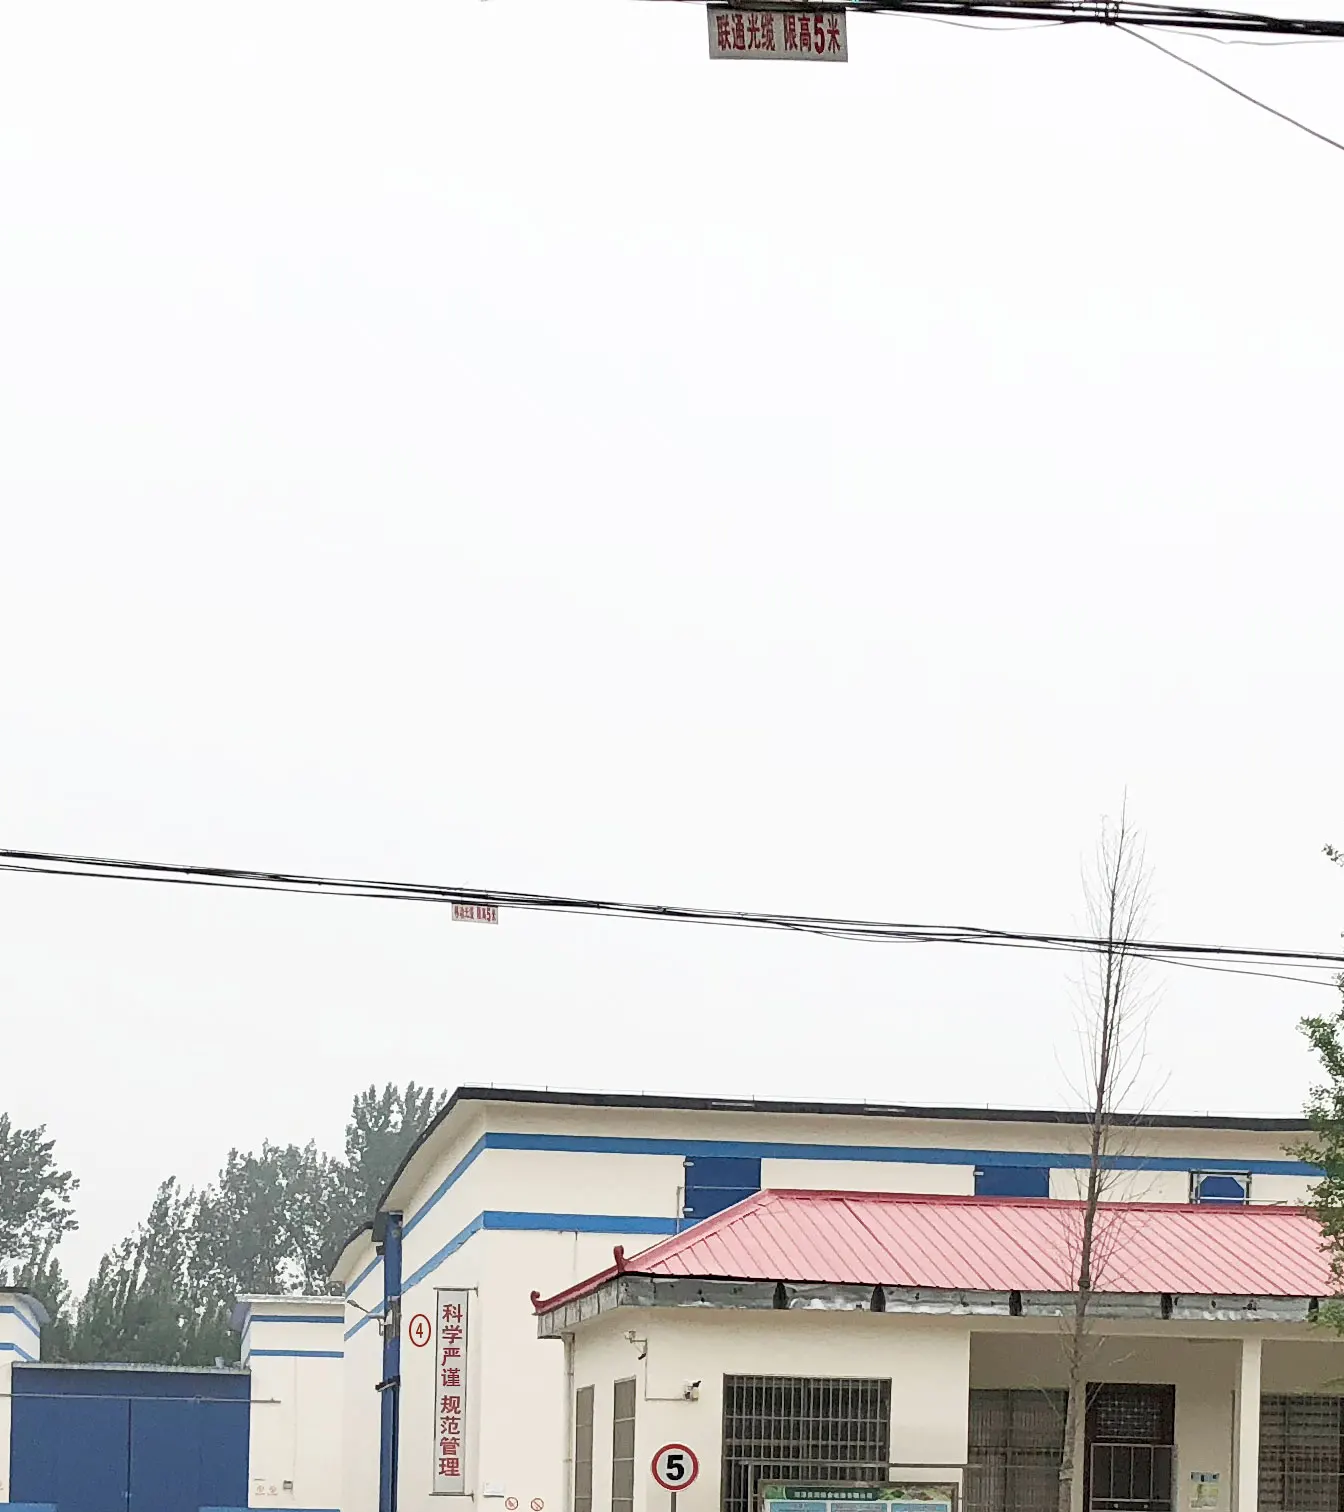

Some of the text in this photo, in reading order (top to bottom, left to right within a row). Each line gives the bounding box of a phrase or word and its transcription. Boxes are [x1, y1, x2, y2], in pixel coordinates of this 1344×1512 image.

[716, 13, 841, 54] 联通光缆 限高5米
[438, 1303, 463, 1477] 科学严谨 规范管理
[666, 1454, 685, 1481] 5
